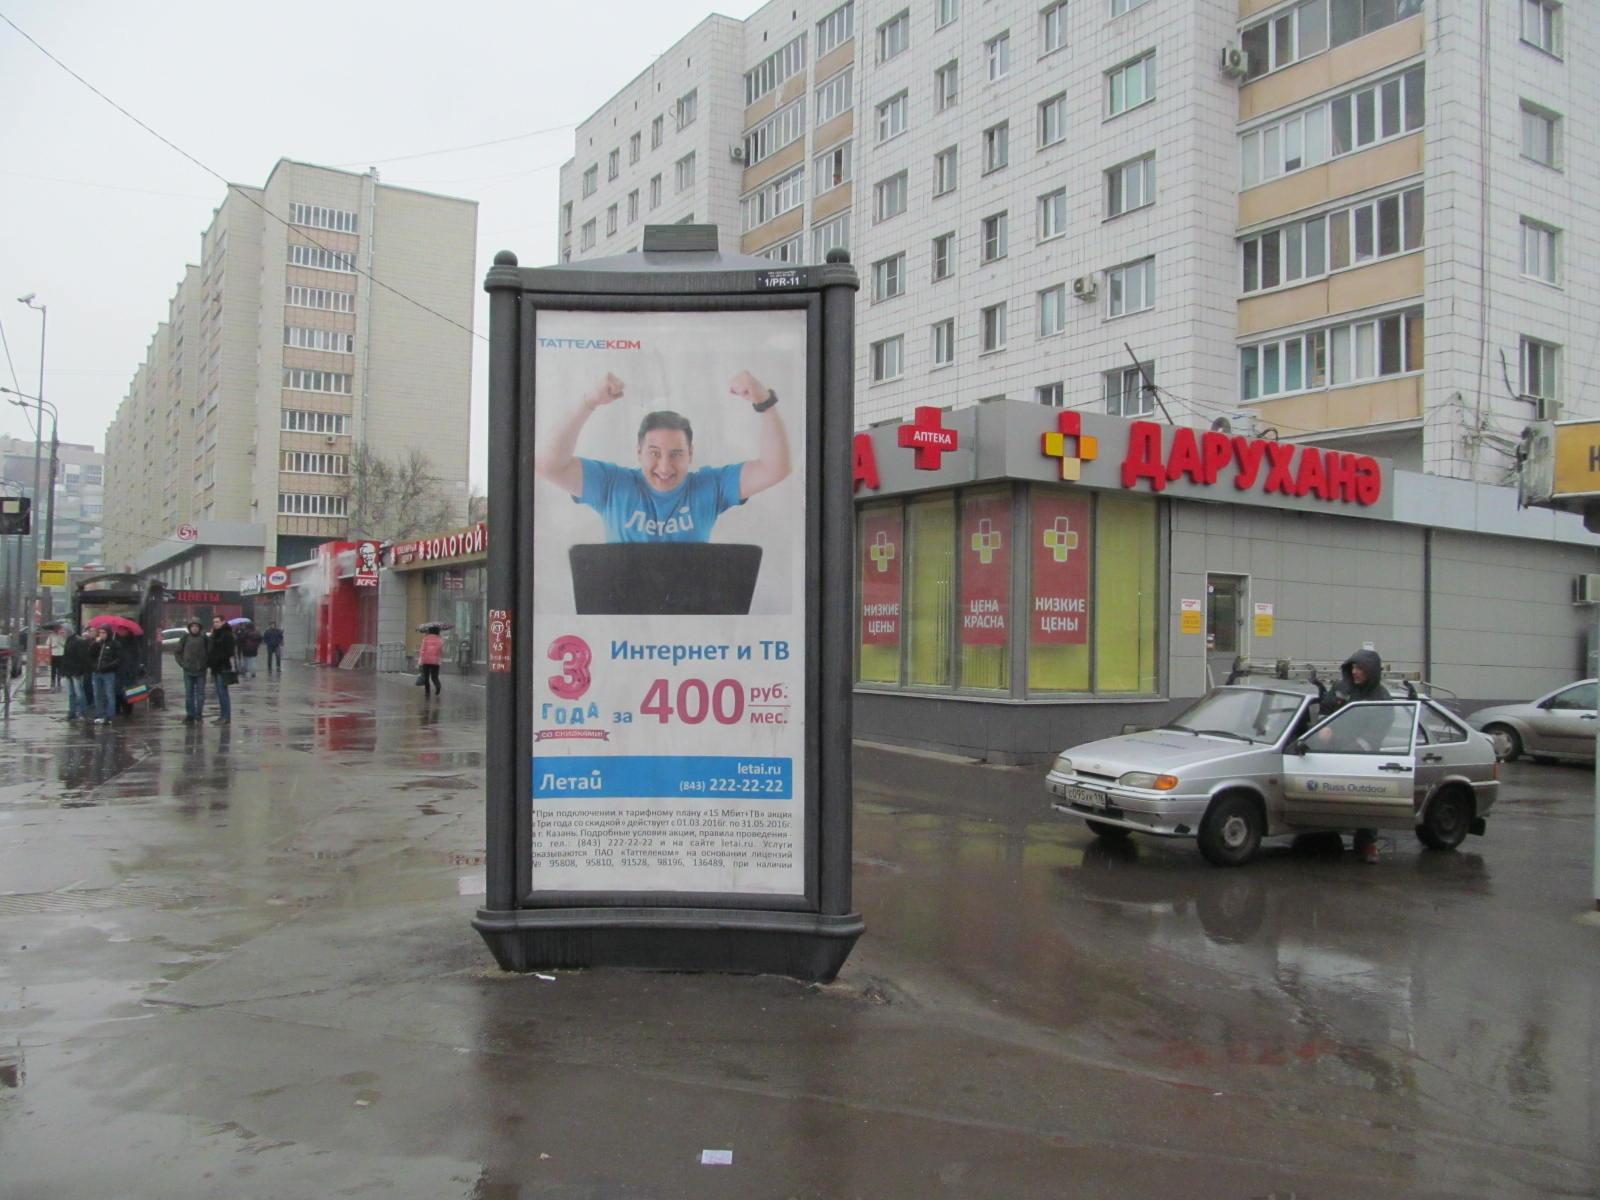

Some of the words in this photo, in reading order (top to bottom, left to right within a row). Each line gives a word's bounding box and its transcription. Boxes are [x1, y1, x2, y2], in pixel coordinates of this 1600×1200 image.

[765, 276, 799, 287] 1/PR-11
[539, 337, 641, 350] ТАТТЕЛЕКОМ
[913, 430, 952, 445] АПТЕКА
[1121, 420, 1381, 506] ДАРУХАНӘ
[624, 506, 695, 537] Летай
[427, 523, 482, 561] ЗОЛОТОЙ
[356, 578, 378, 587] KFC
[864, 603, 900, 617] НИЗКИЕ
[970, 599, 999, 615] ЦЕНА
[1035, 597, 1085, 613] НИЗКИЕ
[490, 609, 507, 620] ГАЗ
[868, 620, 895, 636] ЦЕНЫ
[963, 615, 1005, 629] КРАСНА
[1041, 616, 1079, 632] ЦЕНЫ
[611, 640, 730, 666] Интернет
[737, 645, 751, 660] и
[760, 640, 790, 661] ТВ
[547, 634, 592, 700] 3
[750, 683, 788, 701] руб.
[612, 711, 633, 724] за
[640, 678, 745, 725] 400
[750, 711, 788, 724] мес.
[737, 762, 781, 775] letai.ru
[540, 769, 602, 791] Летай
[679, 780, 706, 792] (843)
[709, 778, 784, 792] 222-22-22
[625, 808, 674, 818] тарифному
[676, 808, 701, 818] плану
[767, 811, 793, 819] акция
[553, 820, 572, 828] года
[626, 818, 669, 828] действует
[580, 829, 631, 839] Подробные
[632, 830, 667, 839] условия
[699, 829, 734, 838] правила
[736, 830, 788, 840] проведения
[608, 838, 653, 847] 222-22-22
[690, 839, 715, 847] сайте
[763, 840, 793, 849] Услуги
[594, 848, 614, 857] ПАО
[701, 849, 747, 858] основании
[751, 850, 793, 859] лицензий
[733, 860, 749, 868] при
[756, 861, 793, 869] наличии
